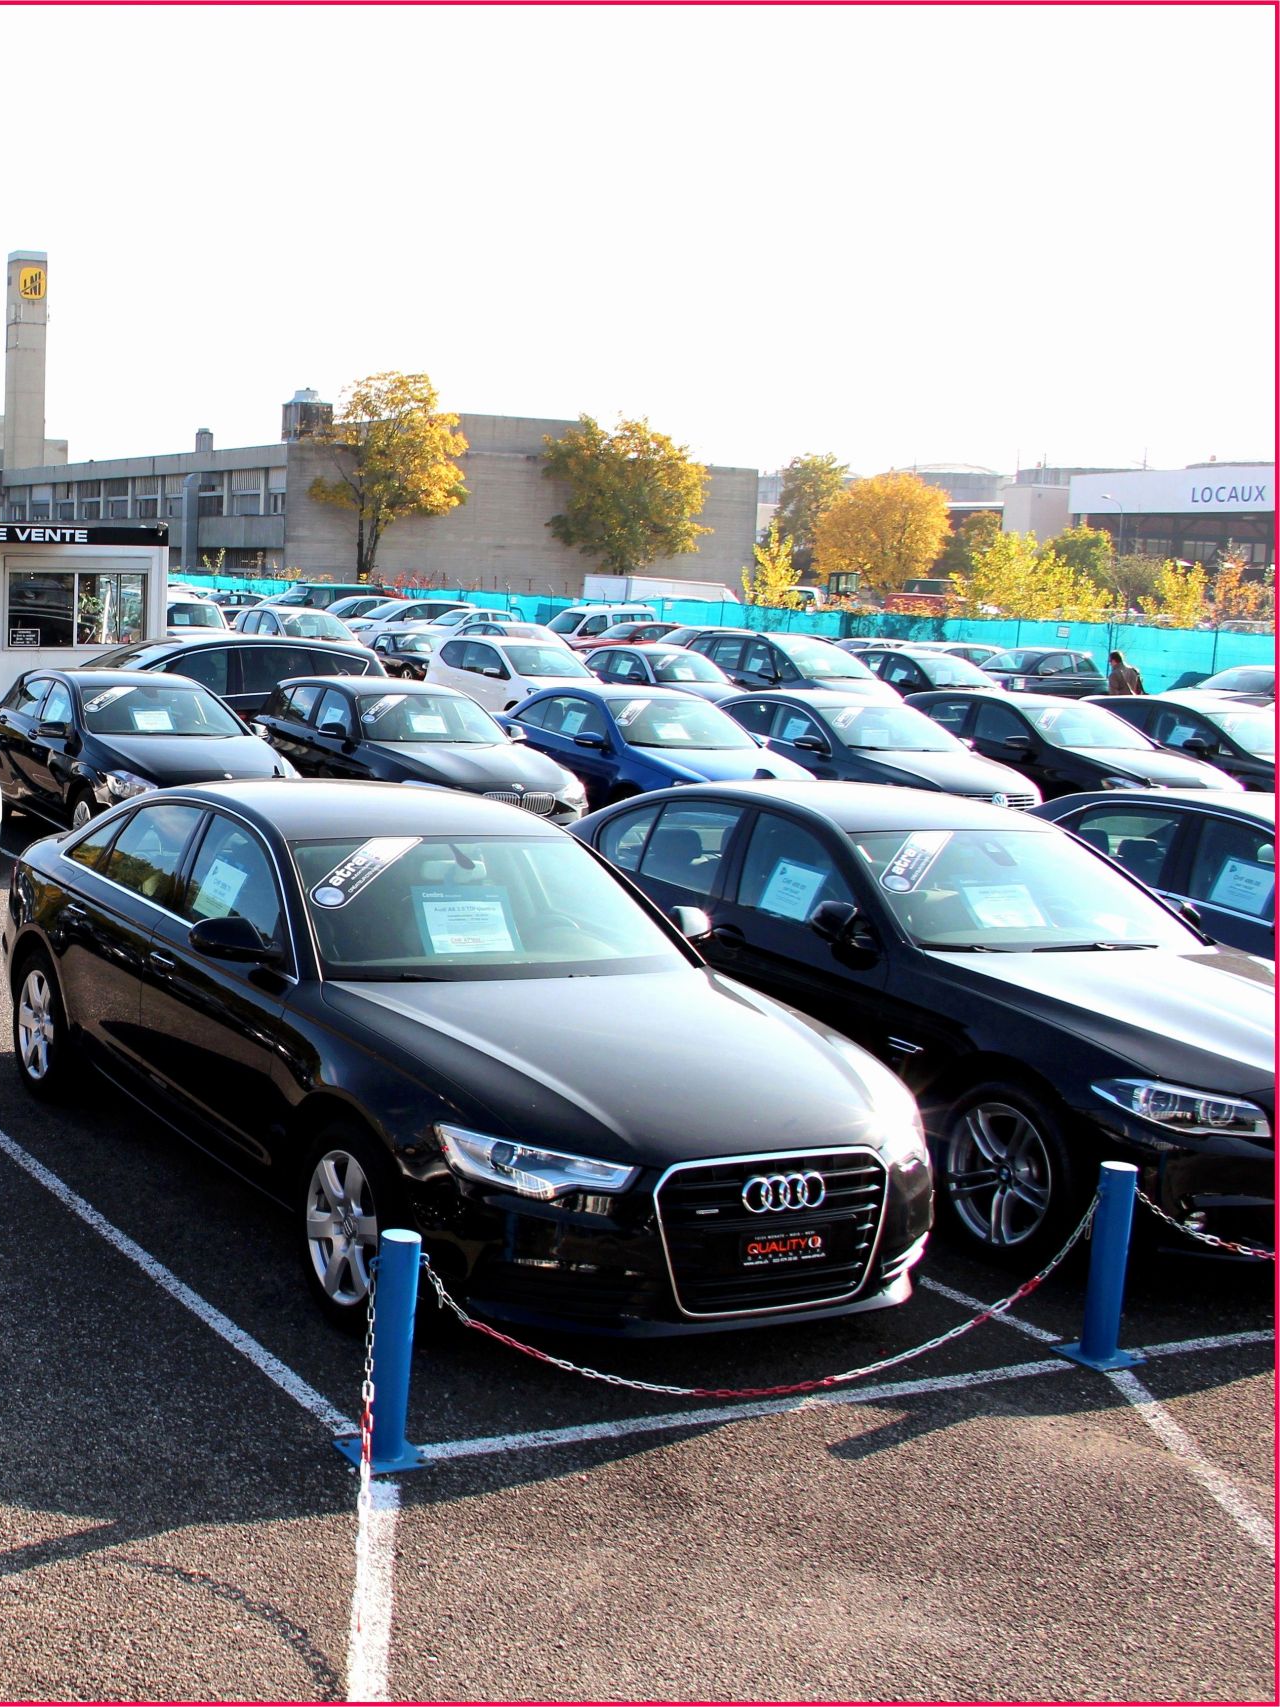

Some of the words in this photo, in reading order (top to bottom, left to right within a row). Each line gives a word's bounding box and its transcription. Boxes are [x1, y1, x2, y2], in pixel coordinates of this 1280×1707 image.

[1190, 485, 1267, 503] LOCAUX
[15, 528, 89, 543] VENTE
[891, 847, 918, 876] atra
[328, 856, 369, 887] atra
[747, 1239, 808, 1255] QUALITY
